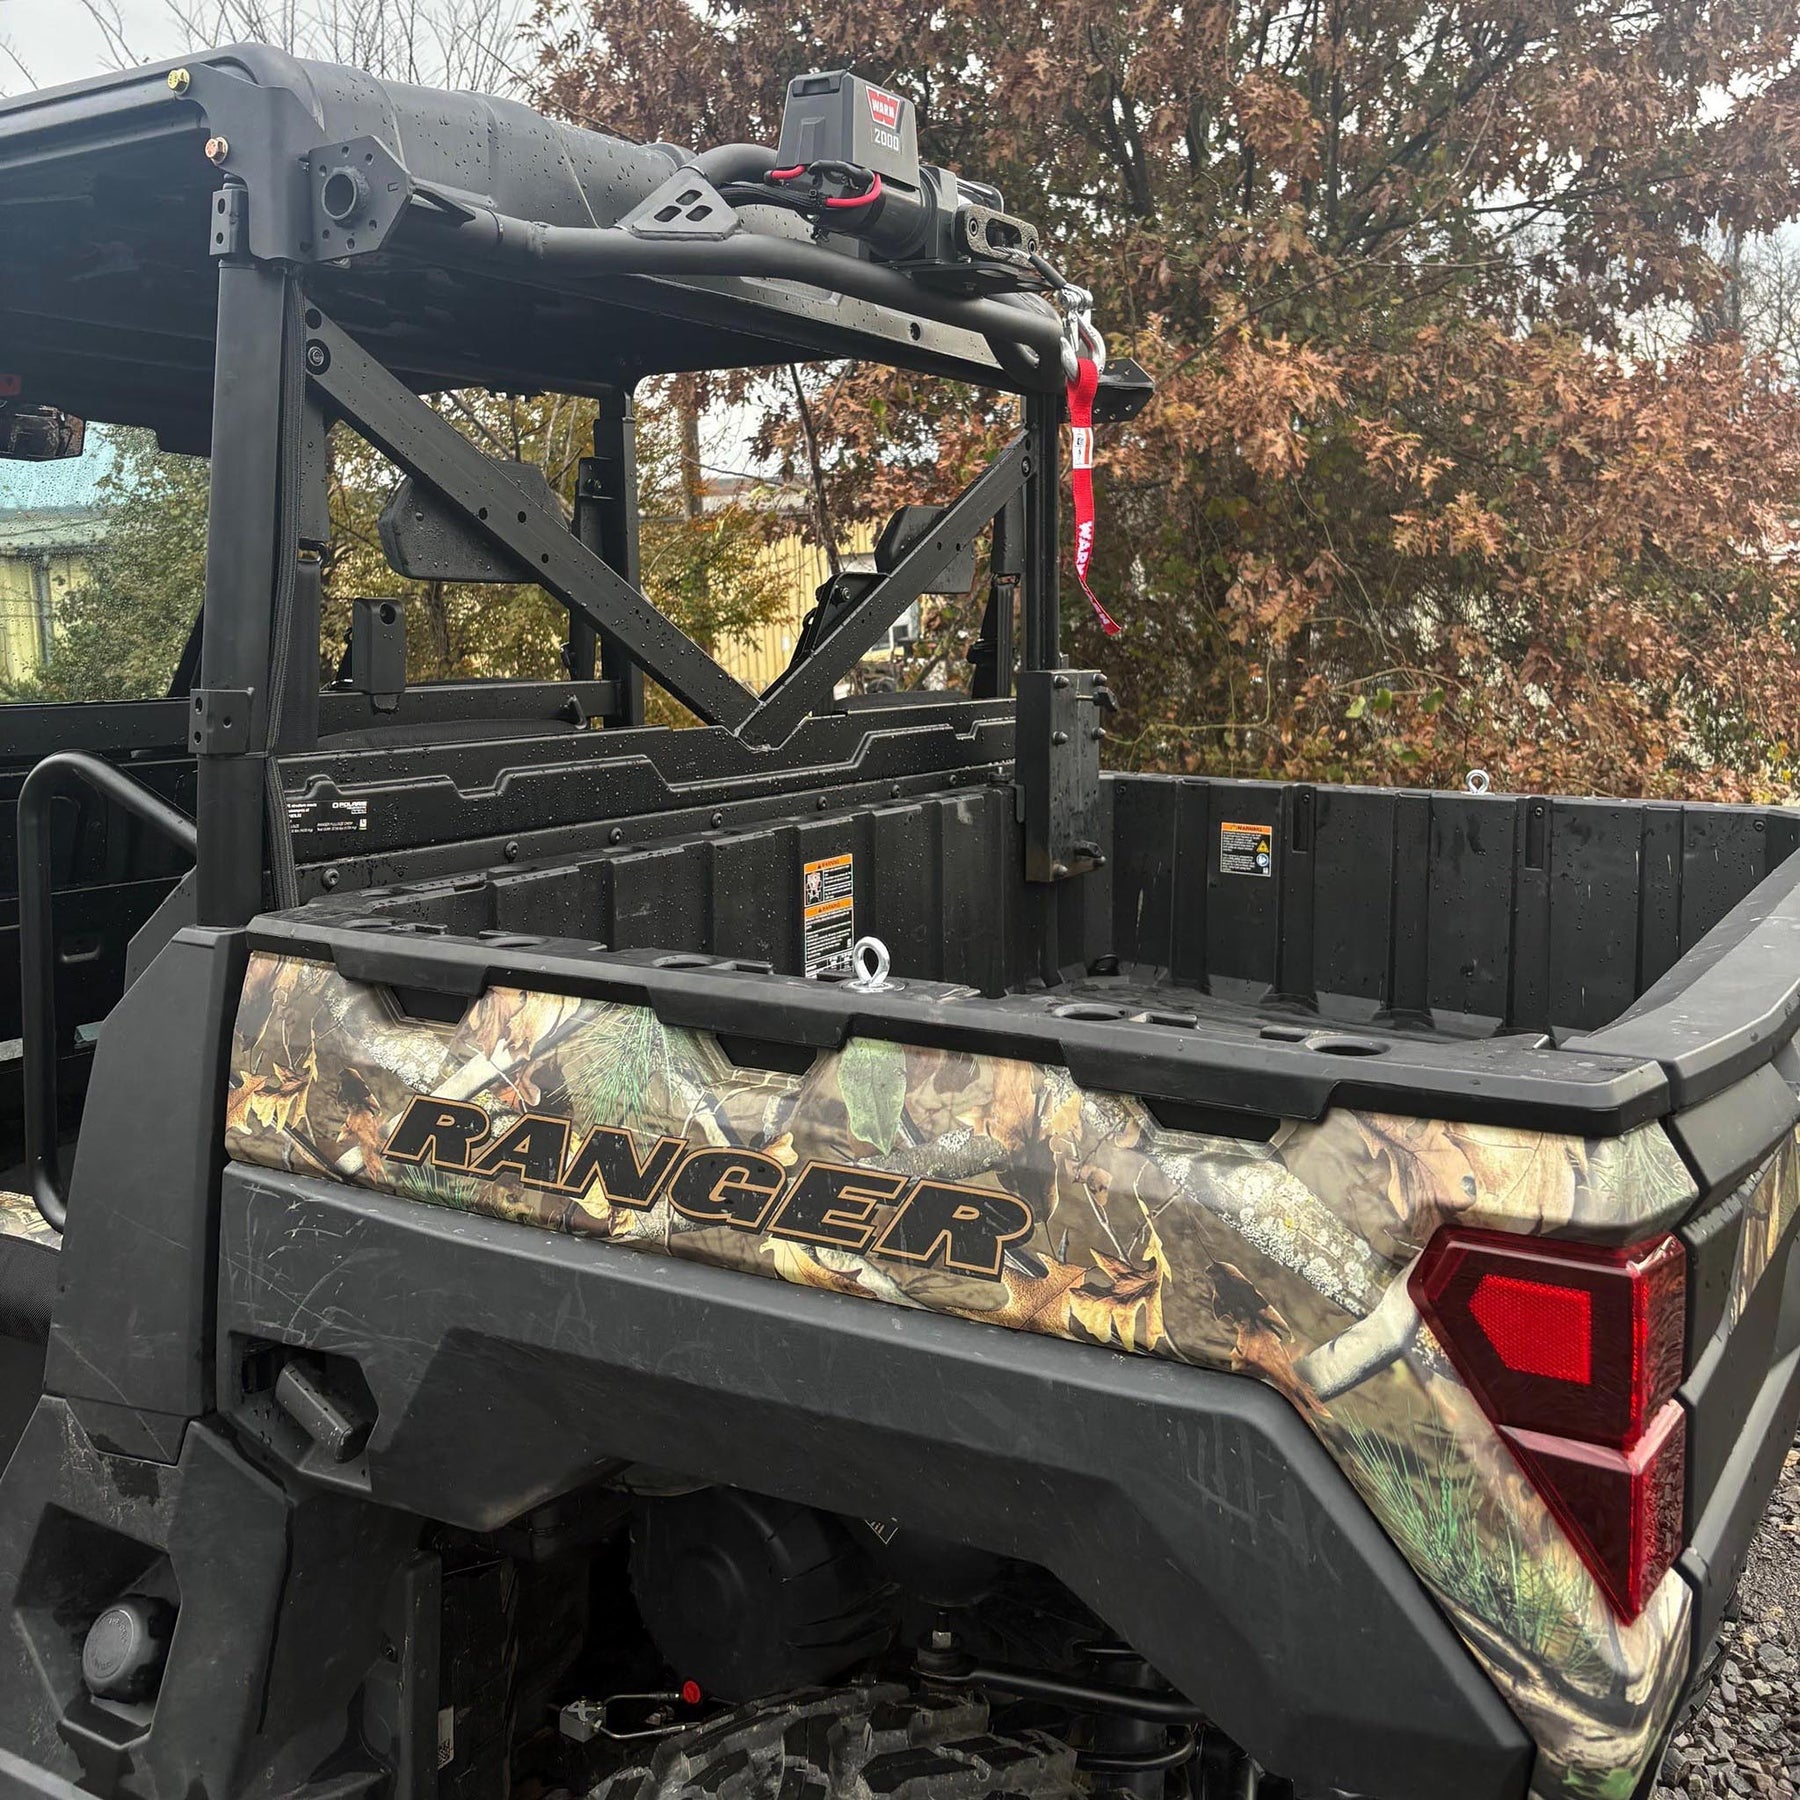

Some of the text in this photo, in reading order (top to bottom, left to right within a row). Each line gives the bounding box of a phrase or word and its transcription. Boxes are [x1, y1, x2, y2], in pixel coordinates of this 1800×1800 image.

[871, 98, 896, 119] WARN
[874, 128, 899, 152] 2000
[1237, 825, 1262, 833] WARNING
[382, 1095, 1034, 1283] RANGER
